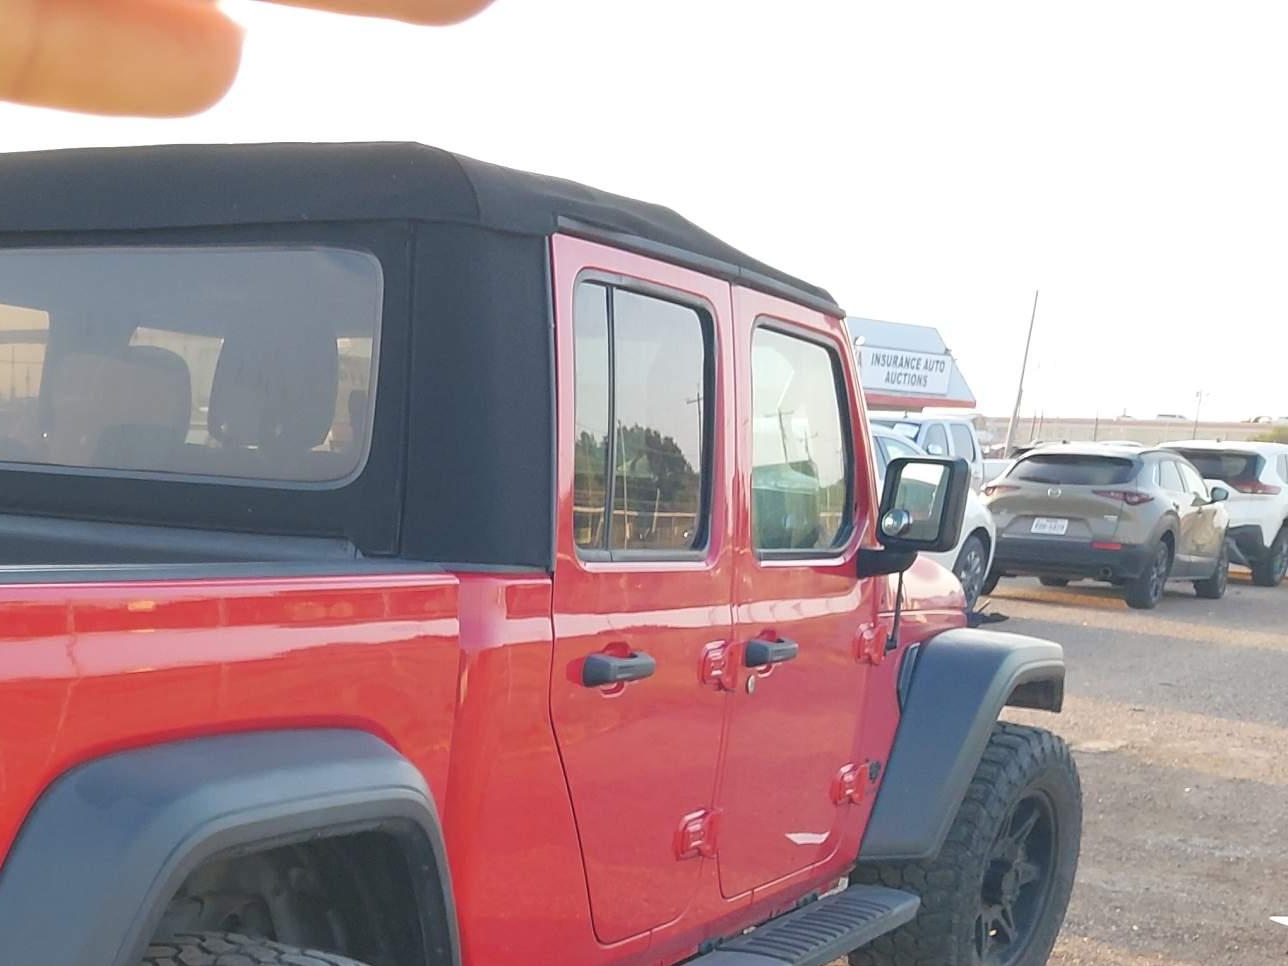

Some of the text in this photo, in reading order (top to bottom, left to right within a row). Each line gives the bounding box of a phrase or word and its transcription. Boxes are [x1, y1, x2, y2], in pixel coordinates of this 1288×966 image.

[871, 352, 921, 370] INSURANCE
[923, 357, 946, 373] AUTO
[885, 371, 928, 387] AUCTIONS
